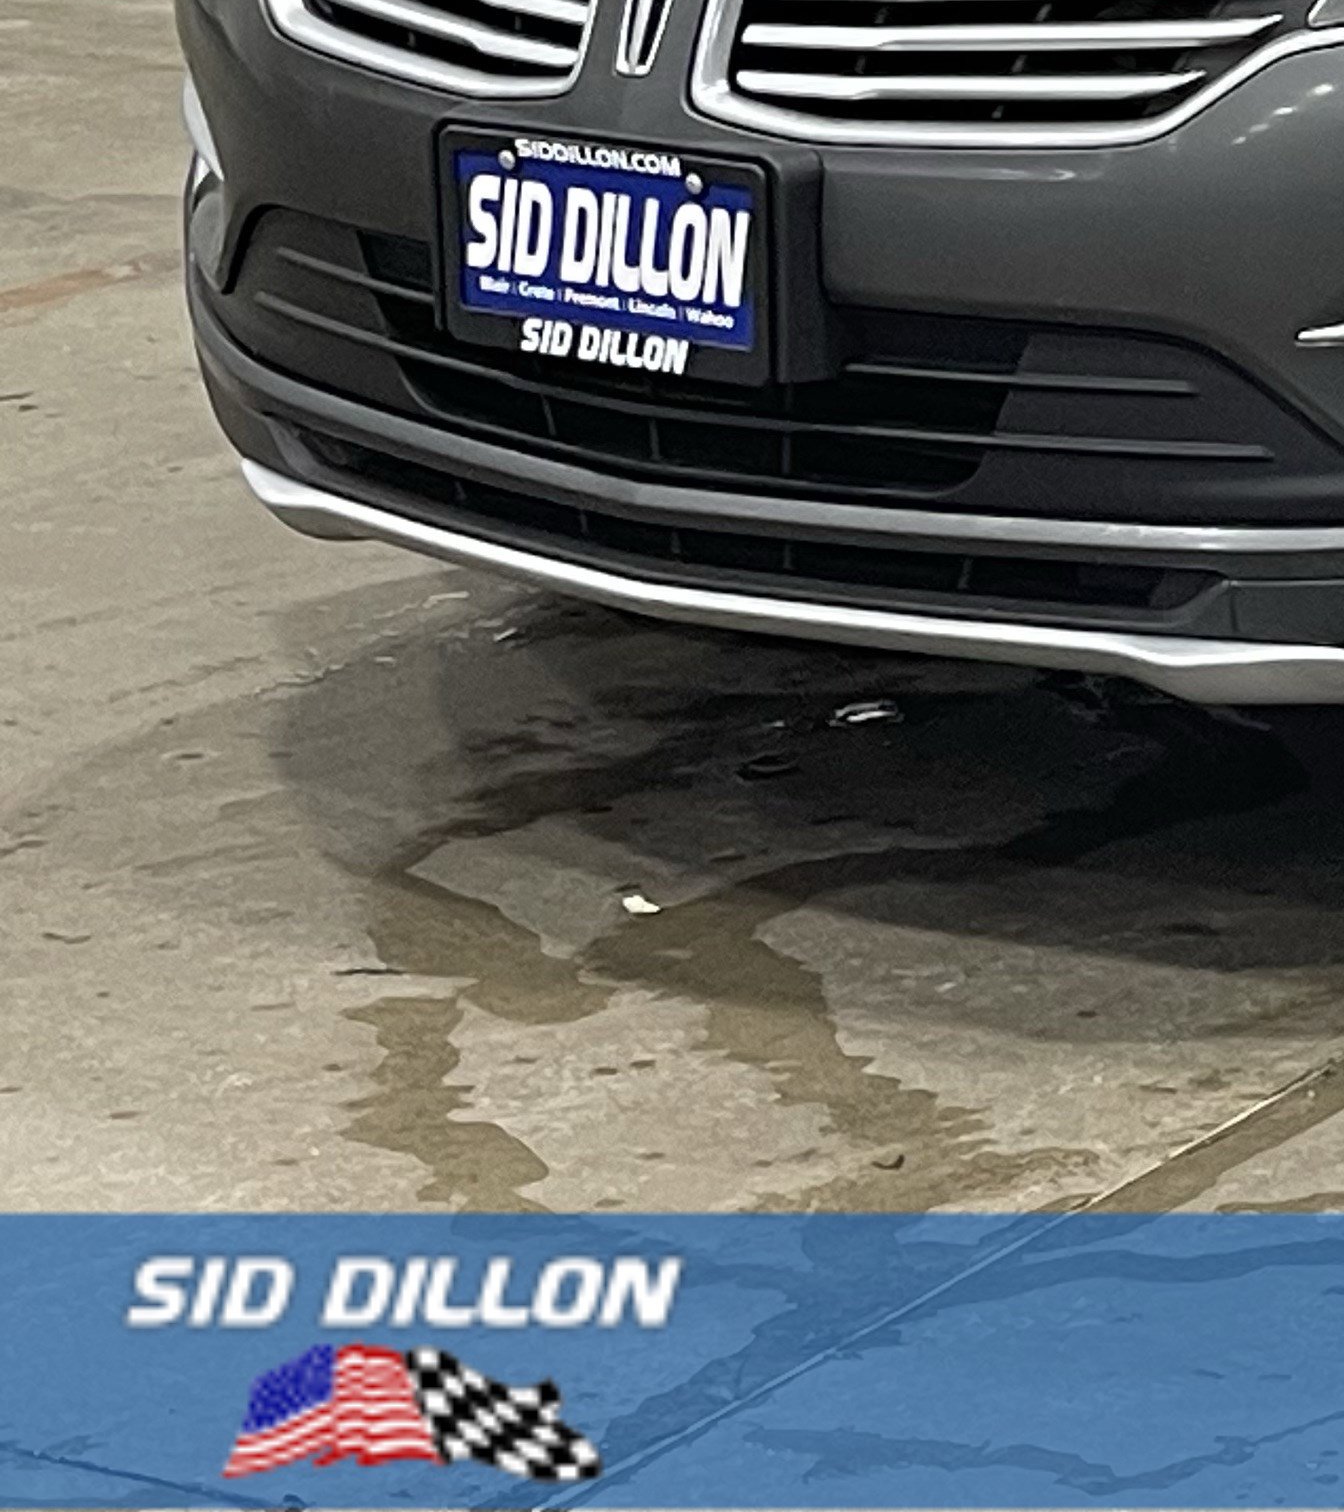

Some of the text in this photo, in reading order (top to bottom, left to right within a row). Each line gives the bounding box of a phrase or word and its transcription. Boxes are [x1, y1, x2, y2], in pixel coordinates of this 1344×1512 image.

[514, 138, 683, 178] SIDDILLON.COM
[465, 173, 751, 309] SID DILLON
[519, 317, 690, 376] SID DILLON
